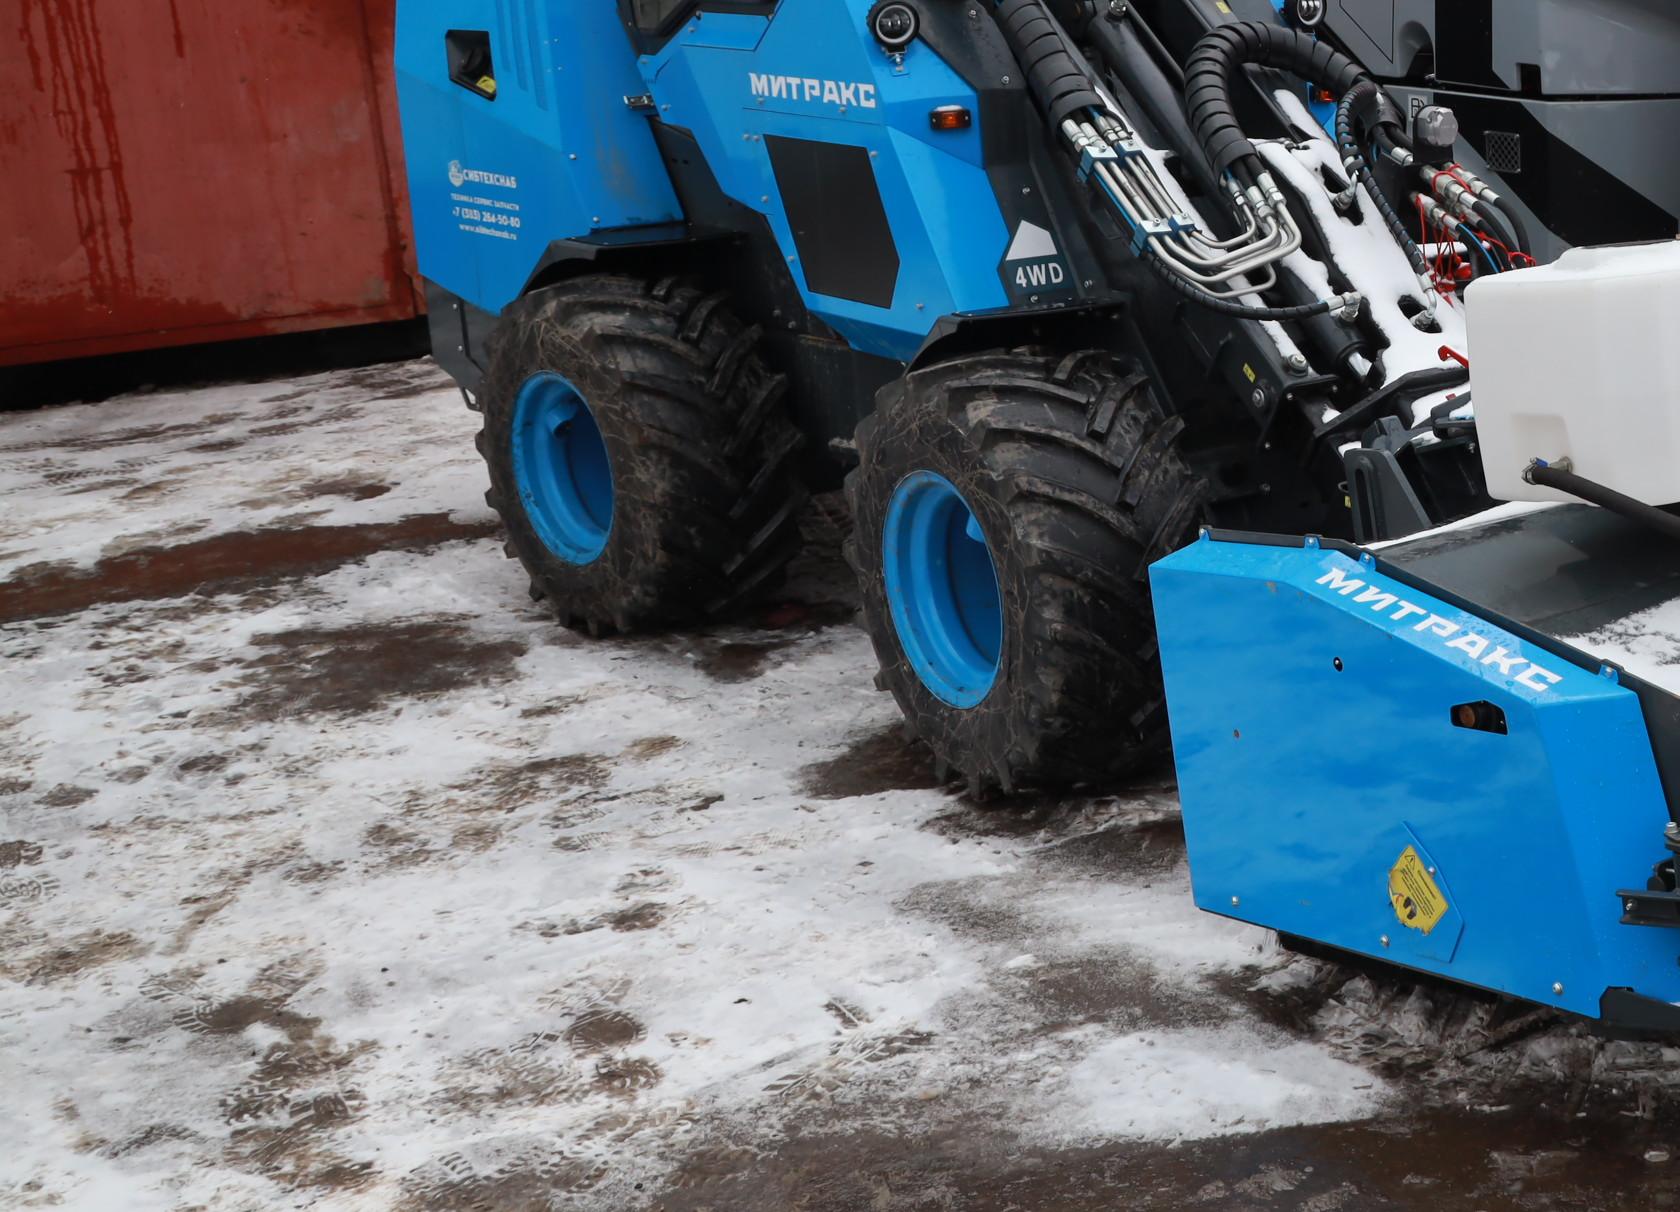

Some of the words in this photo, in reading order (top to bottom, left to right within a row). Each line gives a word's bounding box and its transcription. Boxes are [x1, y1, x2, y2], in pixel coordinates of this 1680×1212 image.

[748, 72, 876, 109] МИТРАКС
[463, 169, 517, 189] СИБТЕХСНАБ
[1015, 262, 1064, 288] 4WD
[1315, 567, 1563, 692] МИТРАКС
